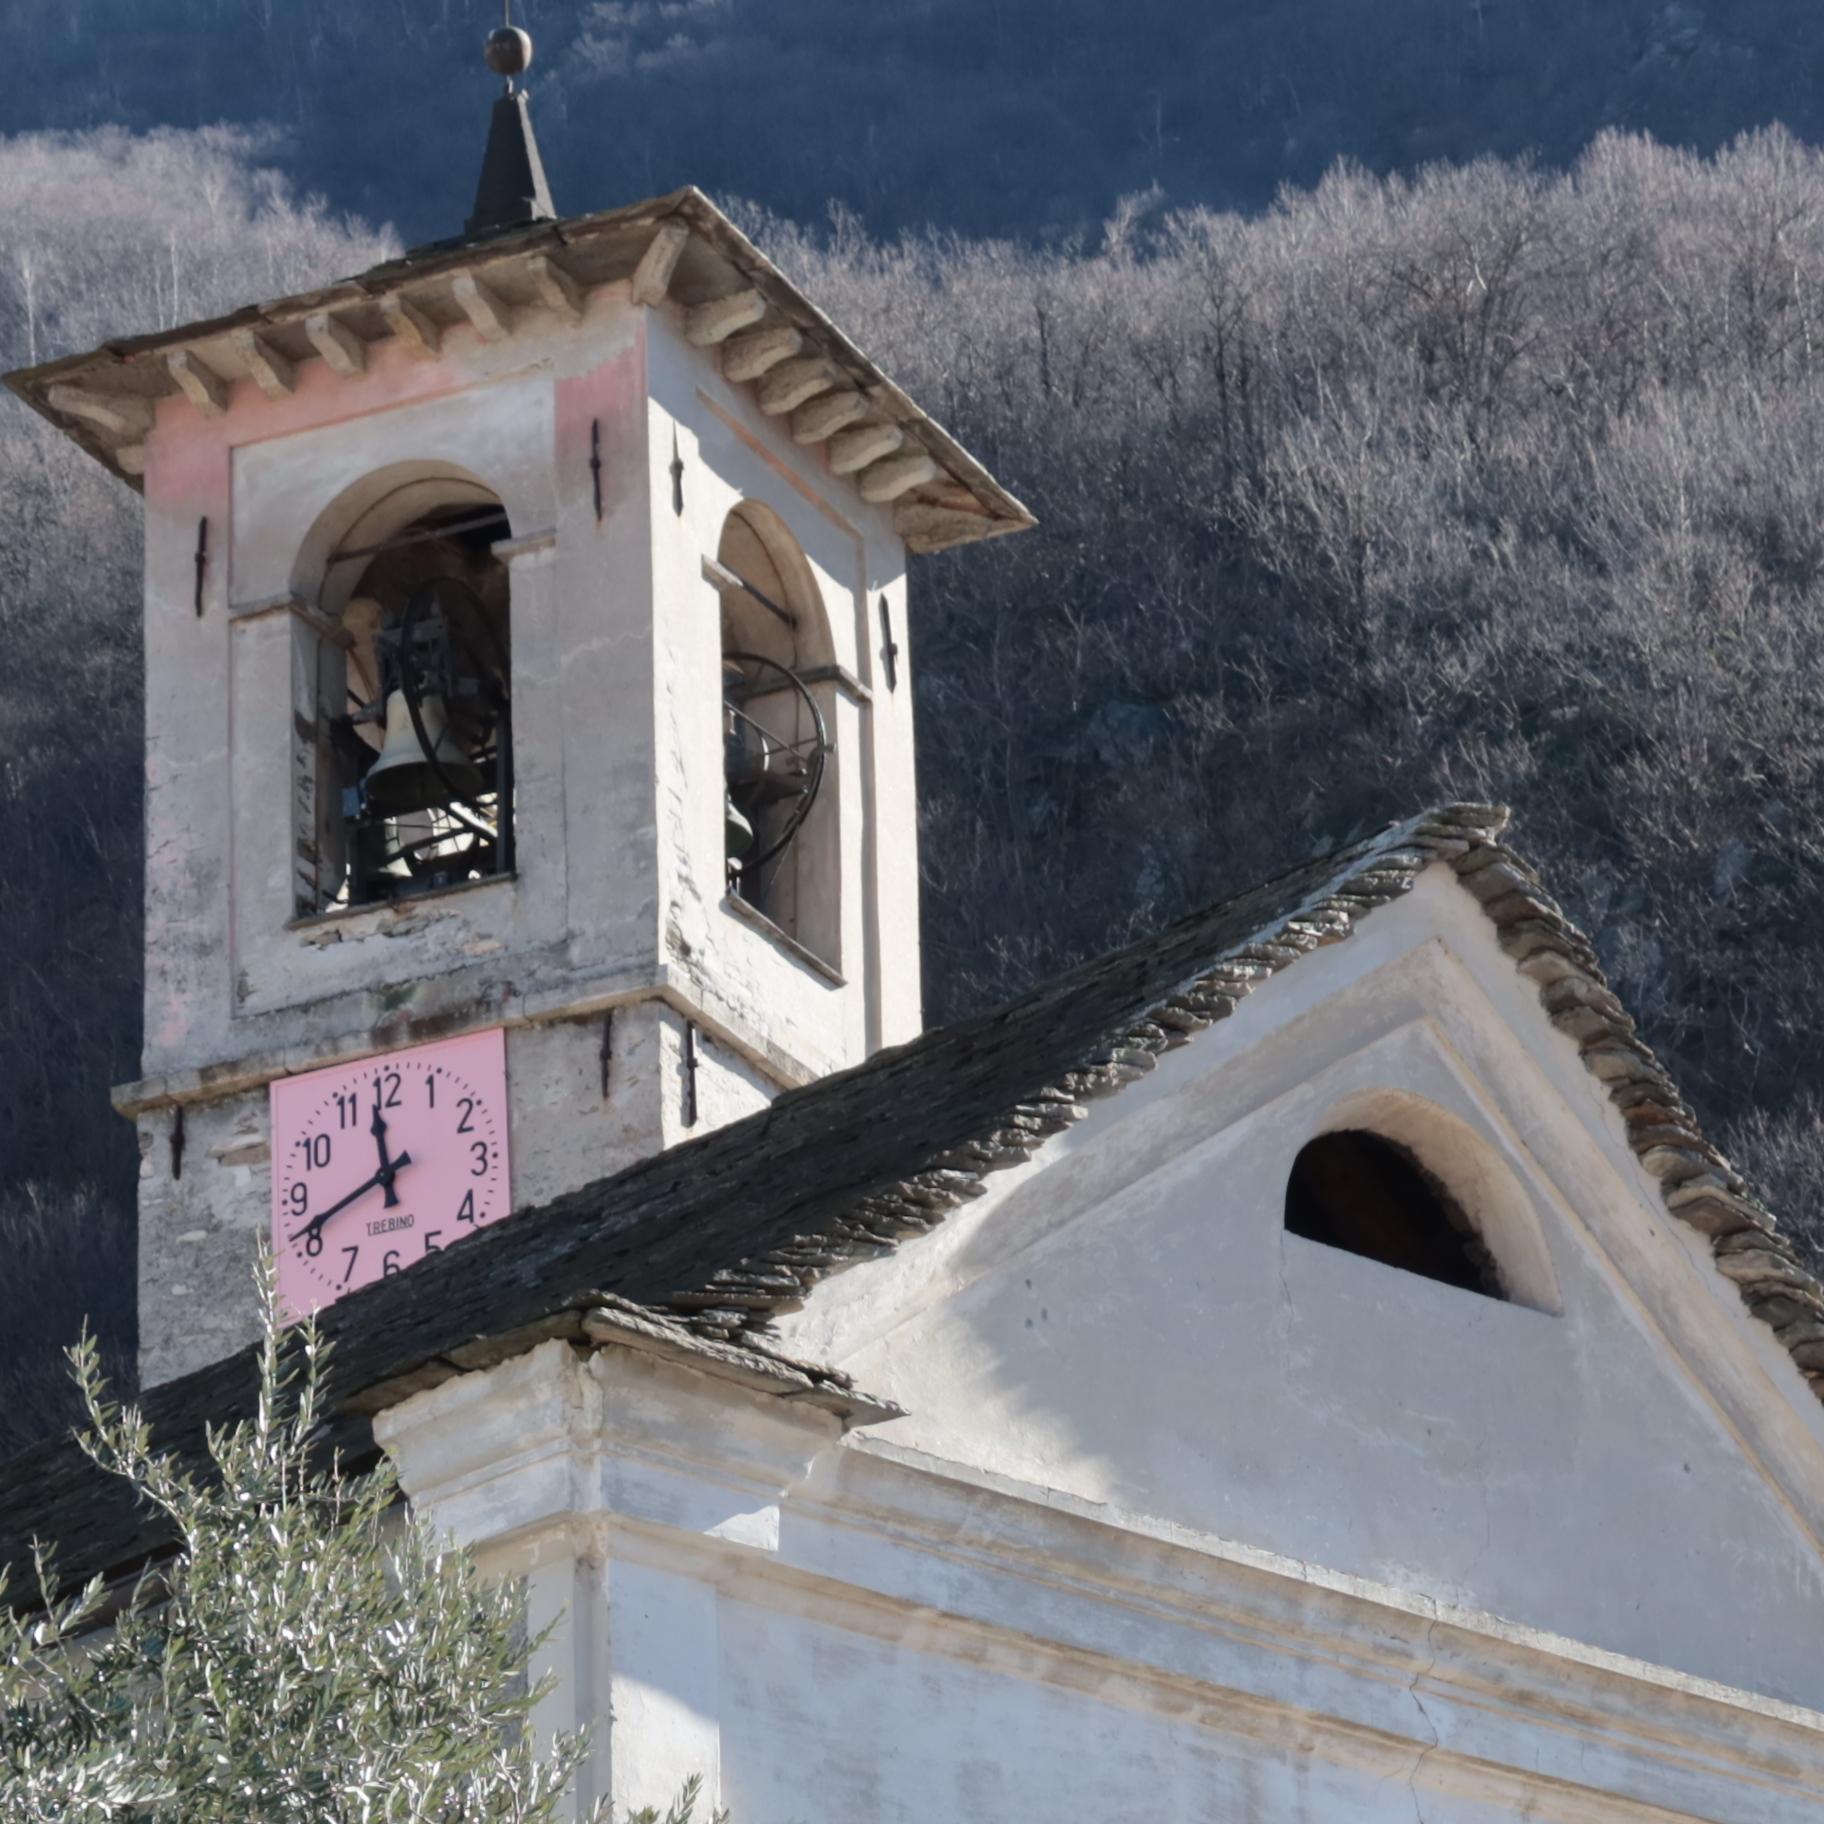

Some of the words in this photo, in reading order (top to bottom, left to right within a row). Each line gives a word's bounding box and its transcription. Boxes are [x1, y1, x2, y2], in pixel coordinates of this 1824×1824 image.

[372, 1073, 402, 1110] 12
[425, 1074, 435, 1109] 1
[336, 1092, 358, 1130] 11
[456, 1097, 474, 1134] 2
[302, 1133, 331, 1171] 10
[470, 1141, 488, 1176] 3
[290, 1182, 308, 1216] 9
[456, 1189, 474, 1224] 4
[306, 1225, 323, 1257] 8
[365, 1213, 415, 1236] TREBINO
[341, 1245, 359, 1283] 7
[383, 1250, 401, 1279] 6
